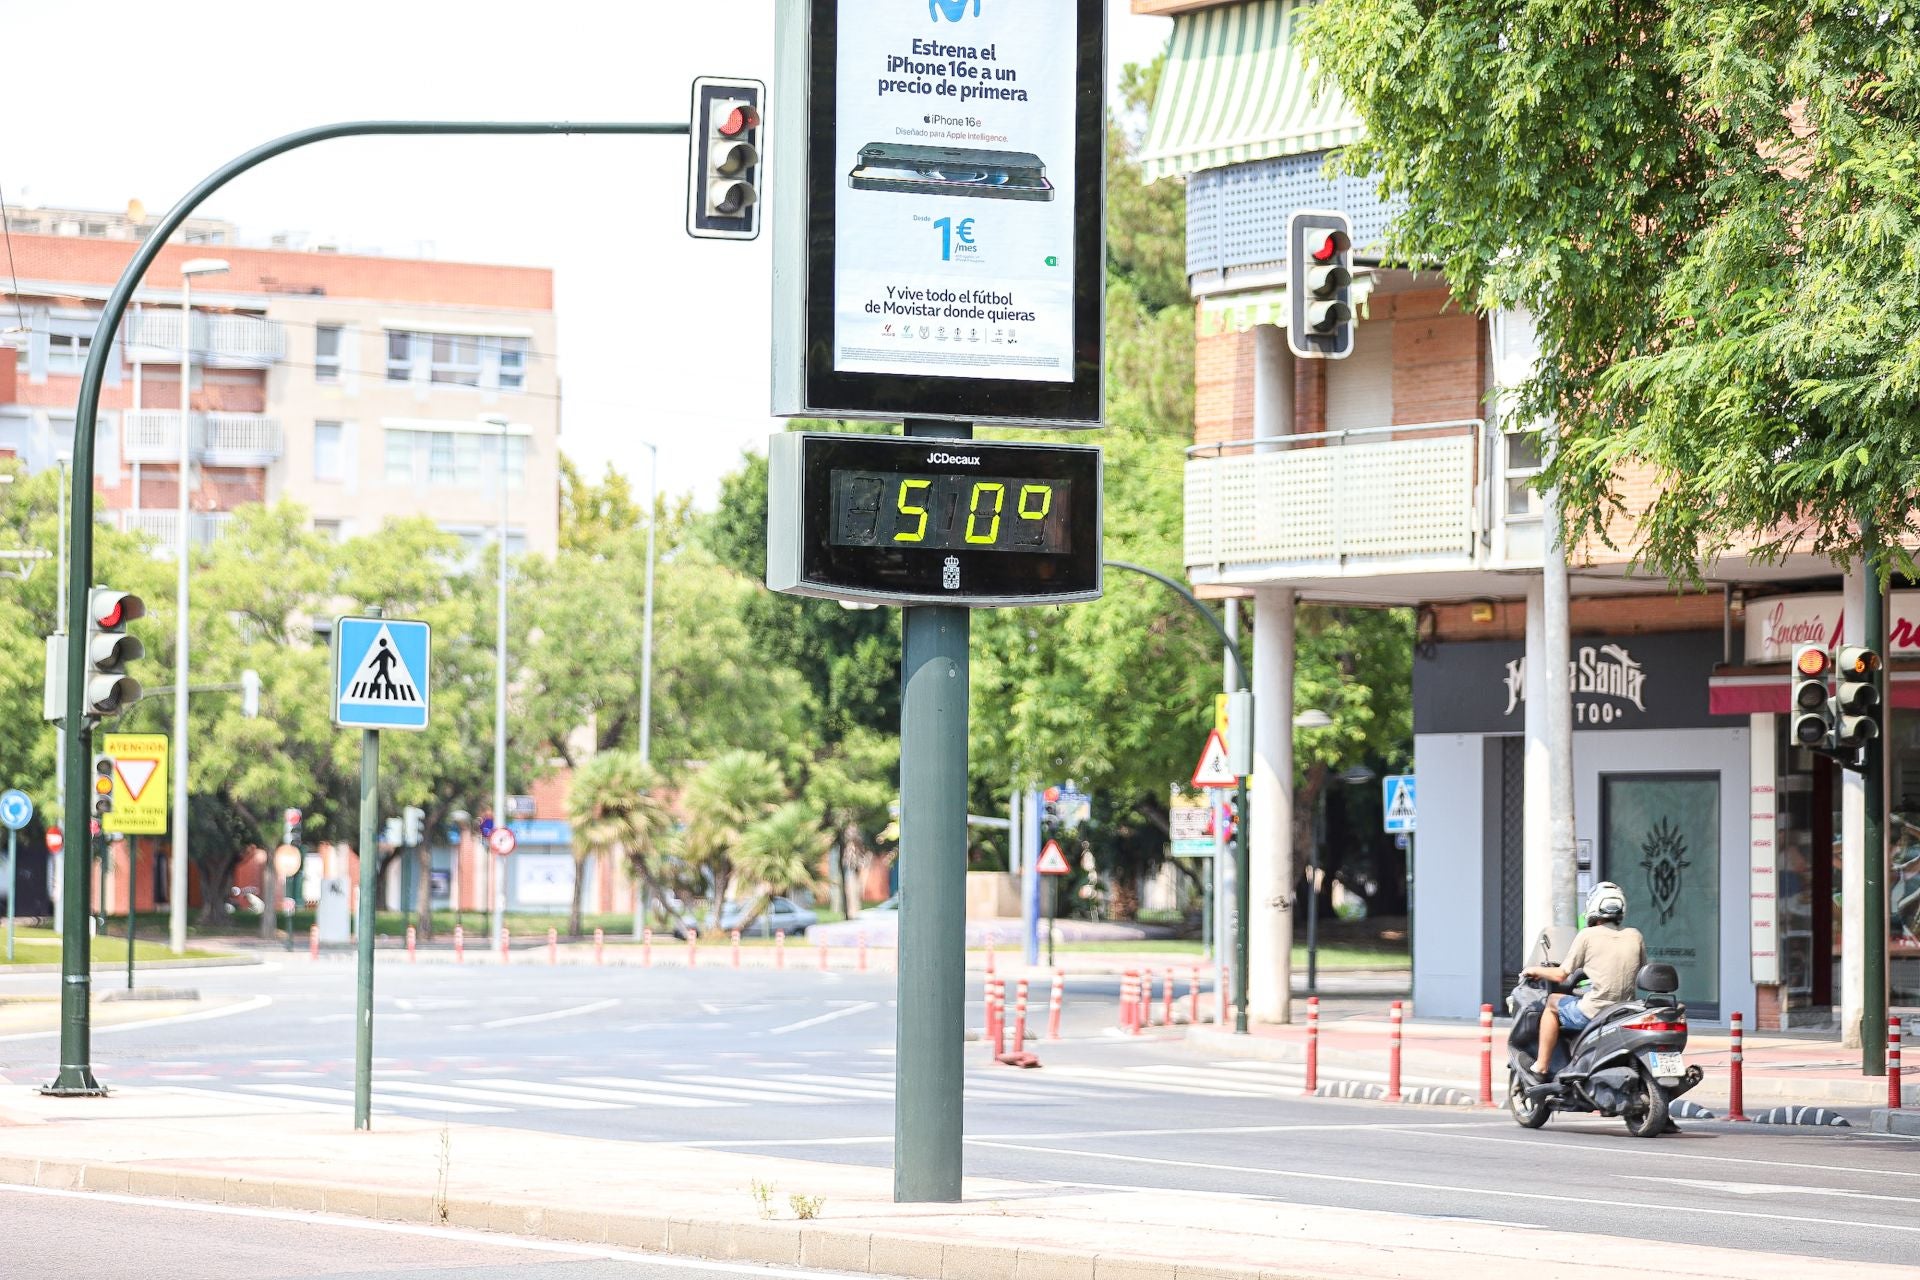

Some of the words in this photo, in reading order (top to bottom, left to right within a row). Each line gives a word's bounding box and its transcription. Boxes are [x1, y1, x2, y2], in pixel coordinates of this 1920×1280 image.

[912, 38, 977, 60] Estrena
[980, 43, 997, 61] el
[887, 55, 946, 76] iPhone
[948, 61, 978, 78] 16e
[981, 67, 992, 80] a
[995, 68, 1016, 81] un
[878, 76, 932, 96] precio
[935, 79, 957, 97] de
[960, 81, 1028, 102] primera
[931, 114, 964, 127] iPhone
[965, 116, 981, 128] 16e
[895, 126, 929, 137] Diseñado
[929, 130, 945, 139] para
[946, 131, 967, 141] Apple
[913, 214, 931, 222] Desde
[954, 242, 977, 253] /mes
[886, 285, 896, 299] Y
[897, 286, 924, 301] vive
[926, 289, 956, 303] todo
[959, 290, 971, 304] el
[973, 290, 1013, 306] fútbol
[864, 300, 881, 314] de
[883, 301, 941, 317] Movistar
[943, 304, 984, 319] donde
[987, 307, 1036, 323] quieras
[926, 452, 981, 466] JCDecaux
